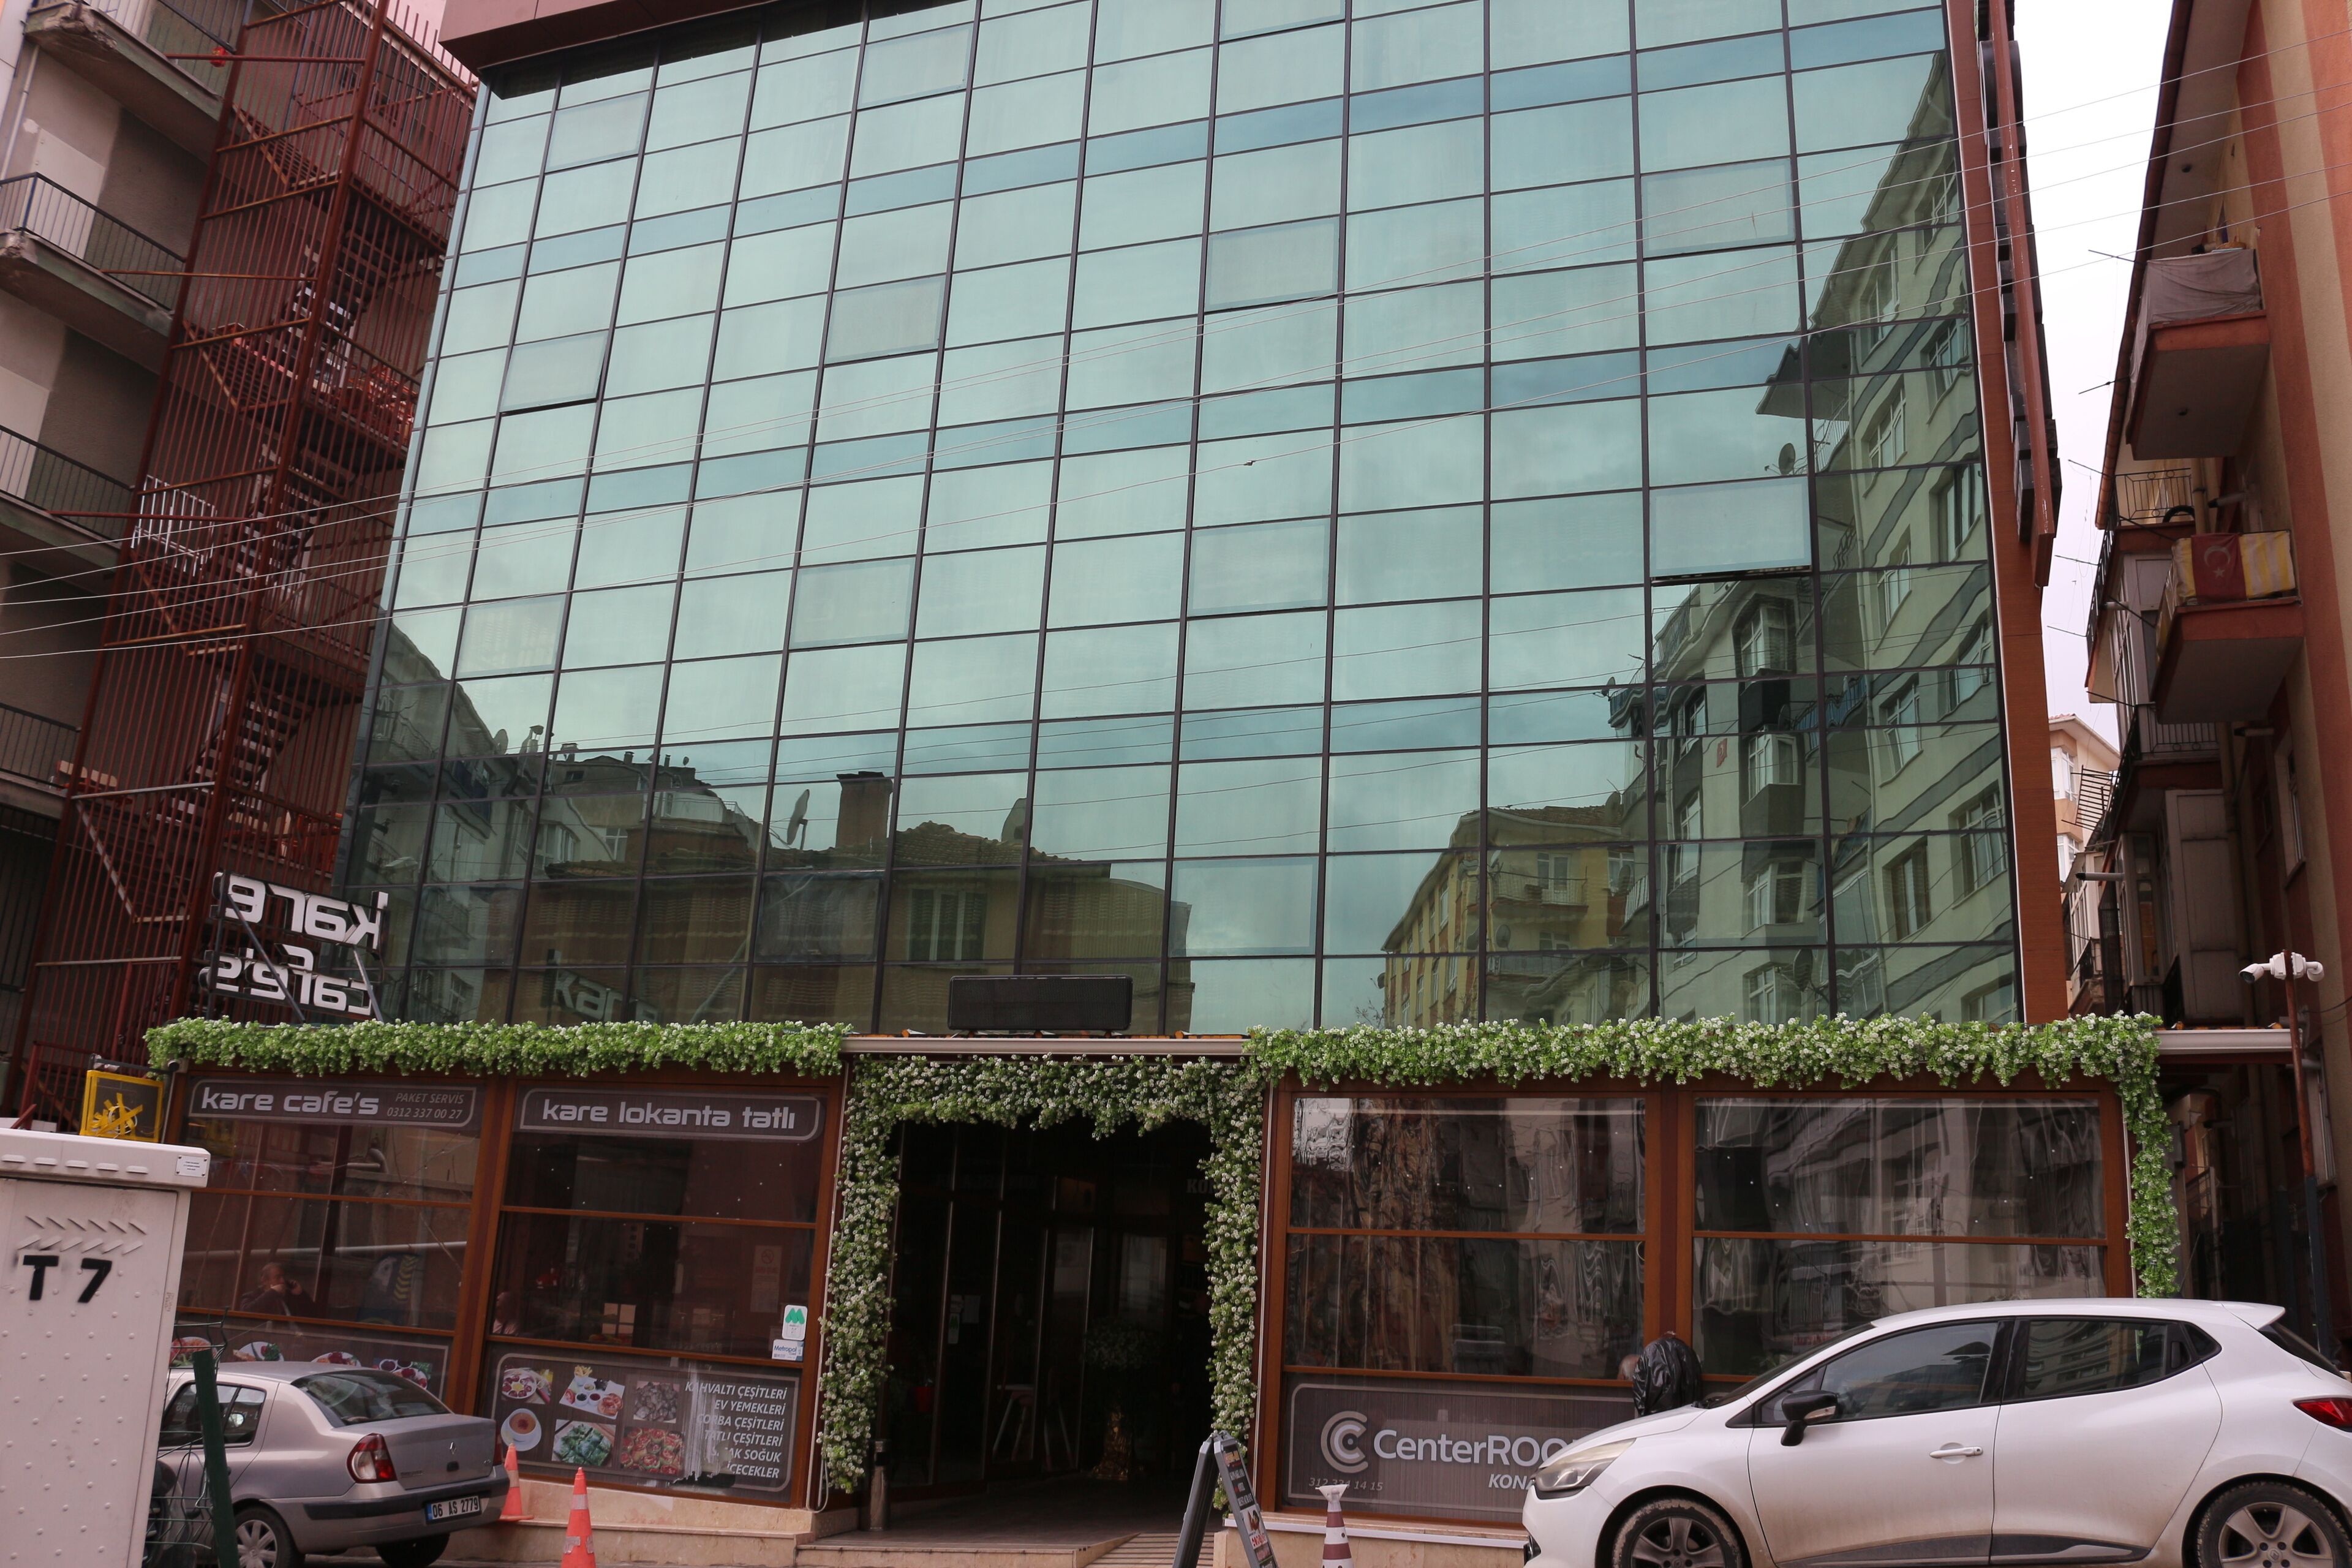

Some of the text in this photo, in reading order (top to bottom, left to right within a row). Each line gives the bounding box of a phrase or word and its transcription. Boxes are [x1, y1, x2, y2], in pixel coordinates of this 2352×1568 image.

[202, 1087, 379, 1115] kare cafe's
[395, 1092, 464, 1104] PAKET SERVİS
[386, 1107, 462, 1120] 0312 337 00 27
[543, 1099, 796, 1129] kare lokanta tatlı
[23, 1254, 59, 1301] T
[78, 1257, 113, 1303] 7
[737, 1385, 788, 1400] ÇEŞİTLERİ
[714, 1400, 786, 1415] EV YEMEKLERİ
[735, 1416, 785, 1431] ÇEŞİTLERİ
[733, 1431, 783, 1447] ÇEŞİTLERİ
[744, 1447, 782, 1463] SOĞUK
[1373, 1429, 1577, 1467] CenterROO
[1354, 1480, 1367, 1490] 14
[1370, 1482, 1383, 1491] 15
[432, 1496, 480, 1518] 06 AS 2779
